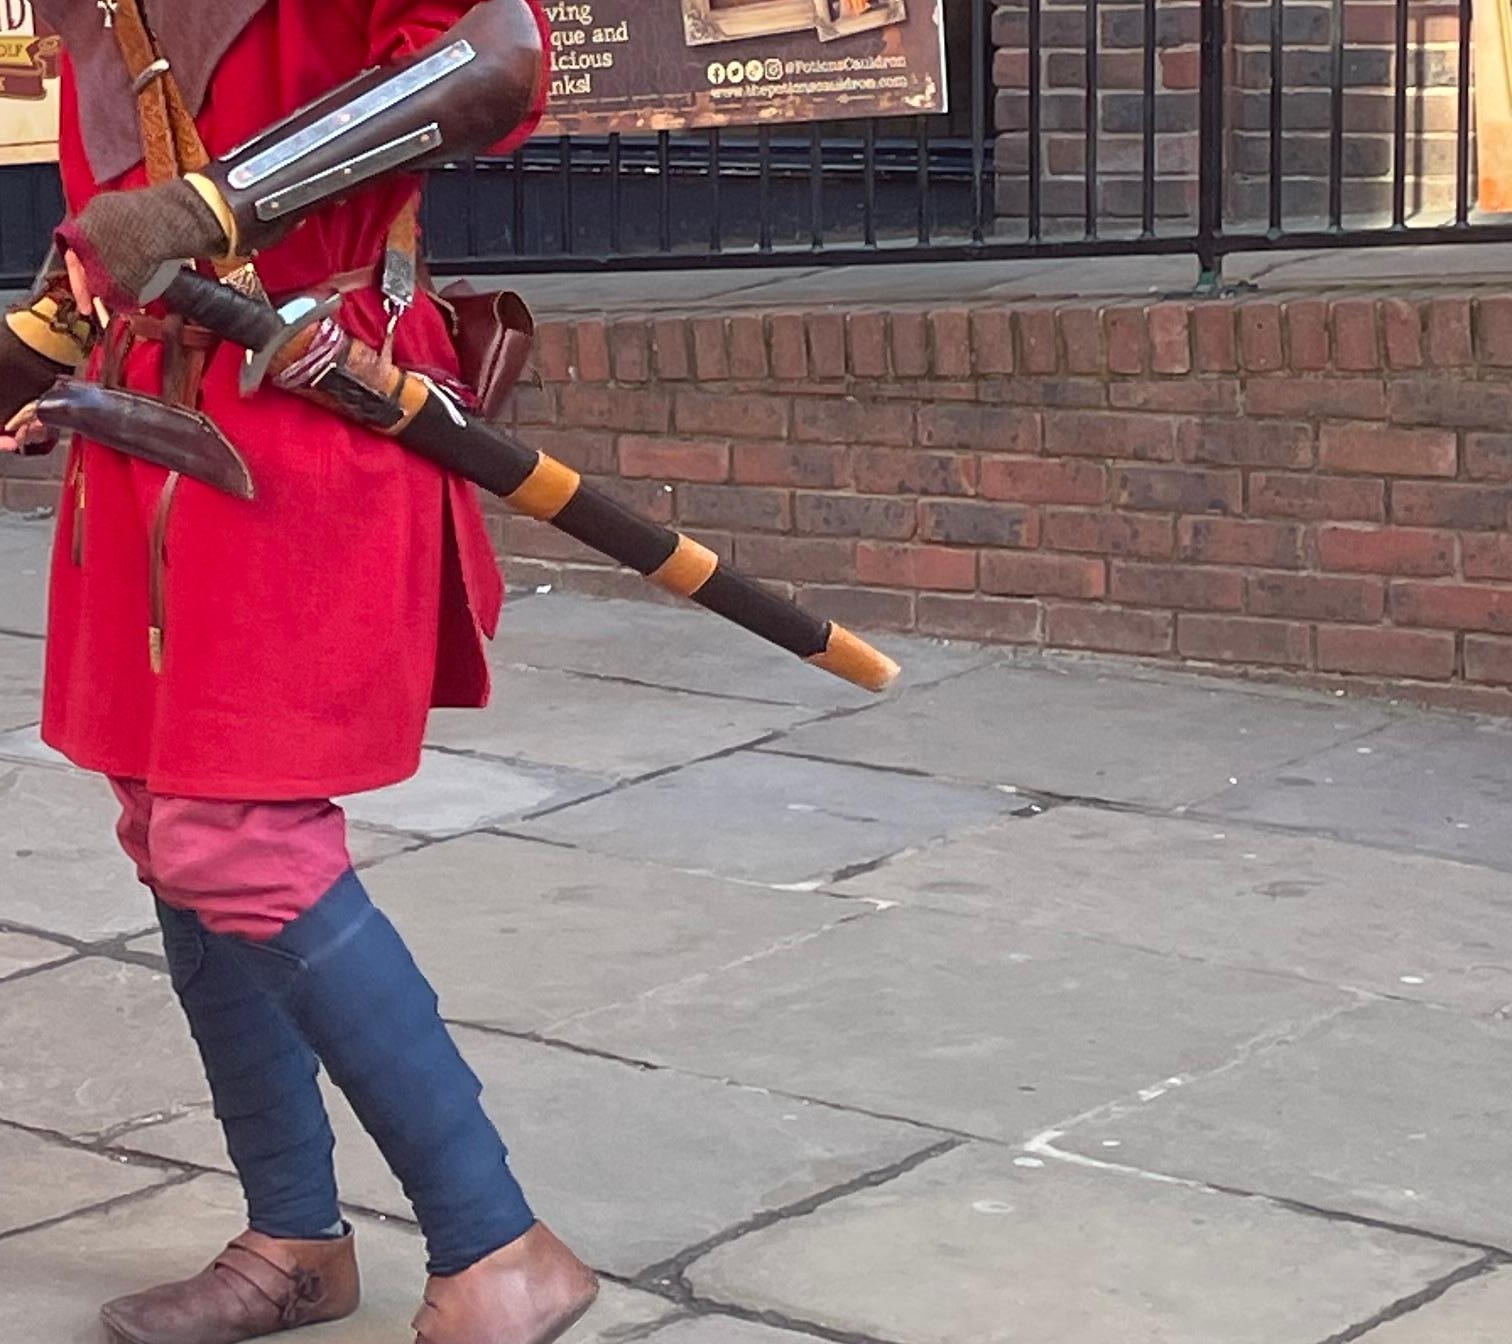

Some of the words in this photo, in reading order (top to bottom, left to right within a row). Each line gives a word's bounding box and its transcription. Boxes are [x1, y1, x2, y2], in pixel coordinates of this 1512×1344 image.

[544, 1, 593, 26] ving
[550, 29, 586, 51] que
[592, 21, 629, 44] and
[550, 50, 613, 72] icious
[550, 73, 592, 96] nks!
